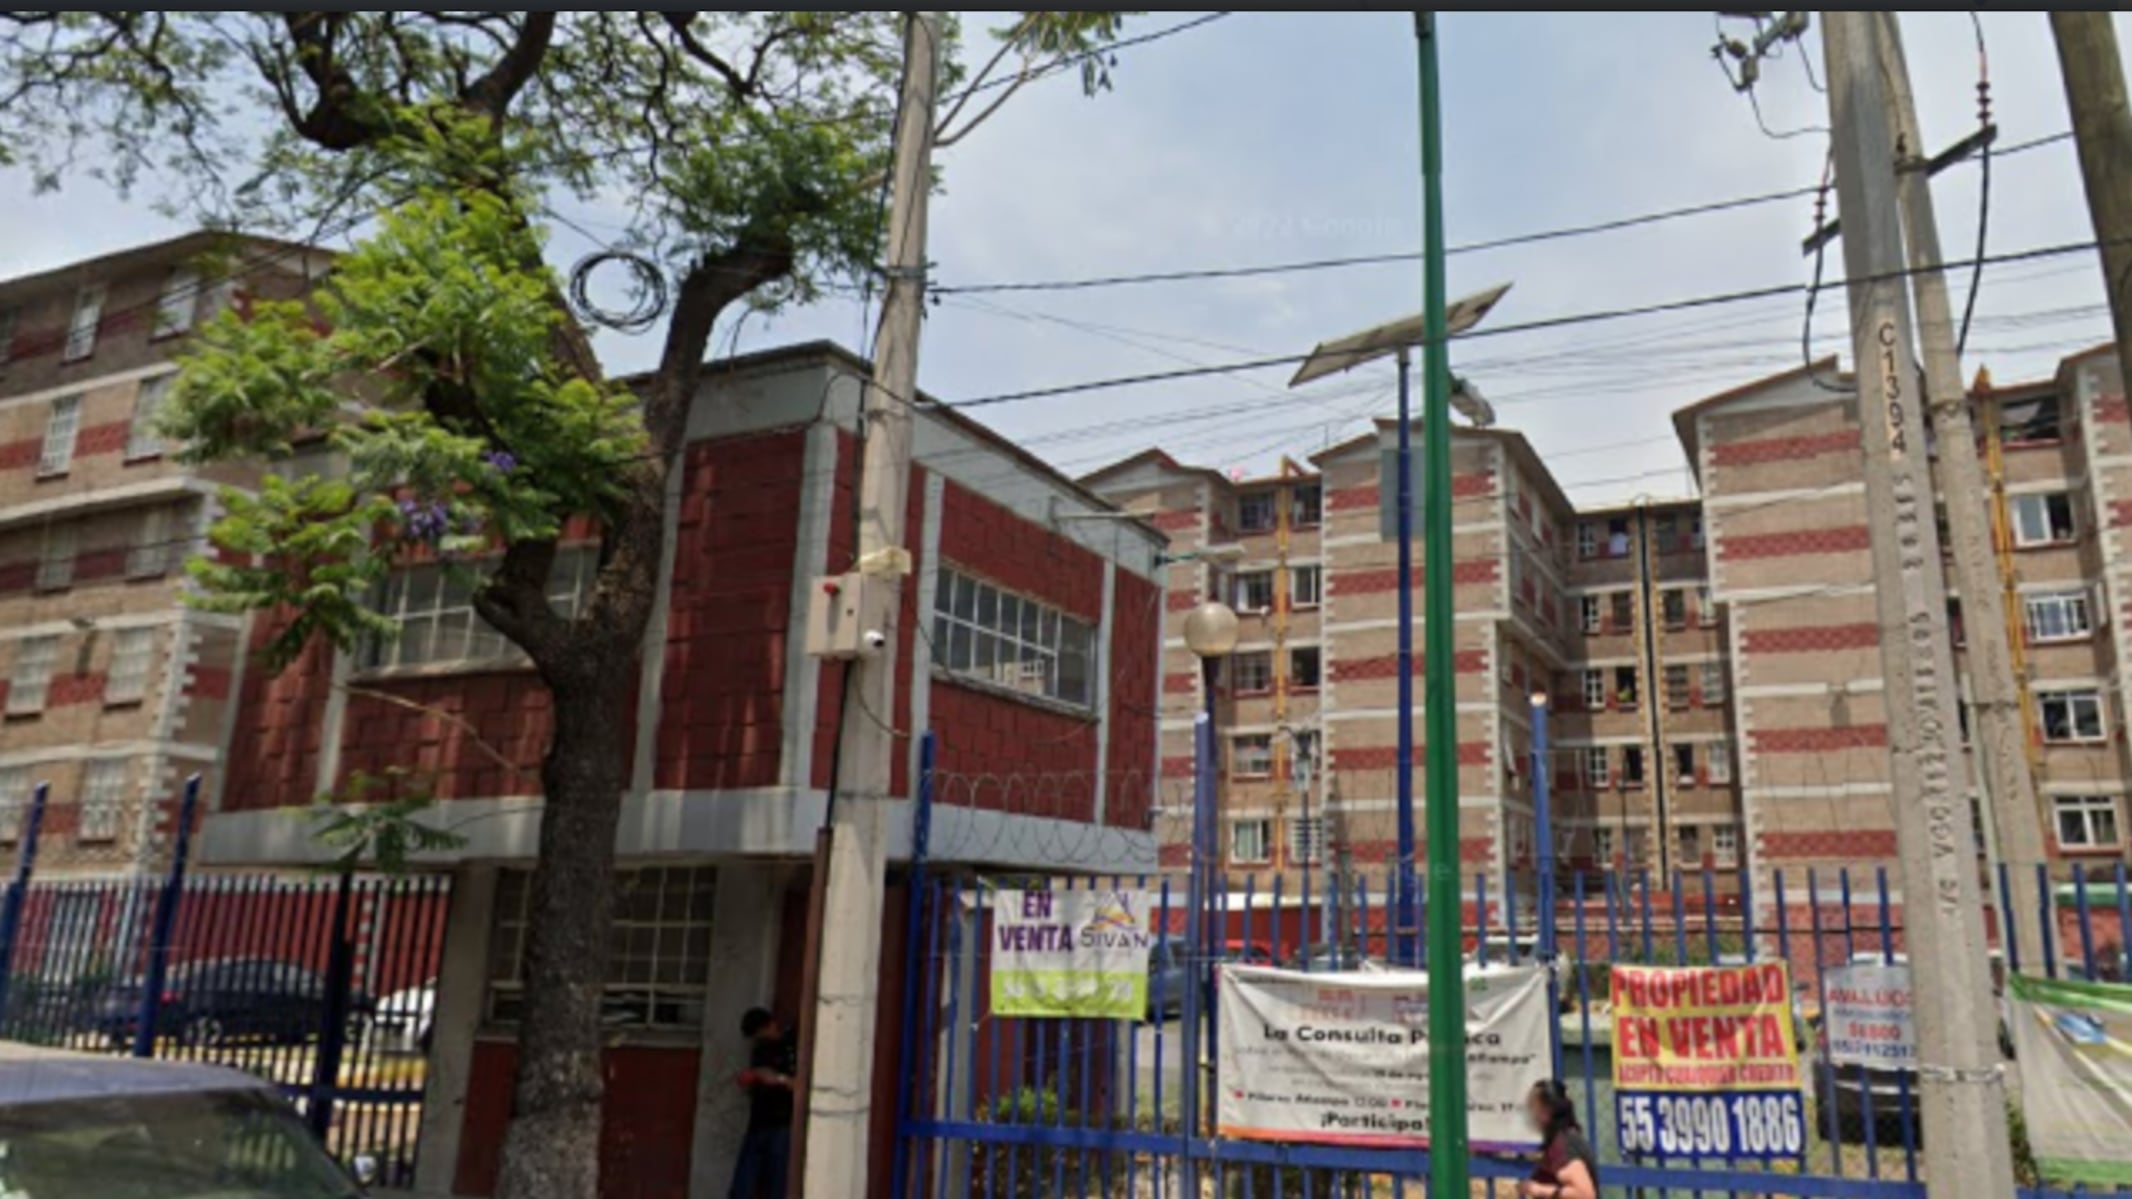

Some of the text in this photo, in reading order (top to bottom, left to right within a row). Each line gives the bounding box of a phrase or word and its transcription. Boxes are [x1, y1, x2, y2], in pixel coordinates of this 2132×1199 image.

[1023, 891, 1053, 917] EN
[1000, 926, 1074, 951] VENTA
[1611, 963, 1785, 1007] PROPIEDAD
[1264, 1024, 1288, 1042] La
[1296, 1024, 1403, 1045] Consulta
[1618, 1014, 1785, 1059] EN VENTA
[1620, 1096, 1801, 1152] 55 3990 1886
